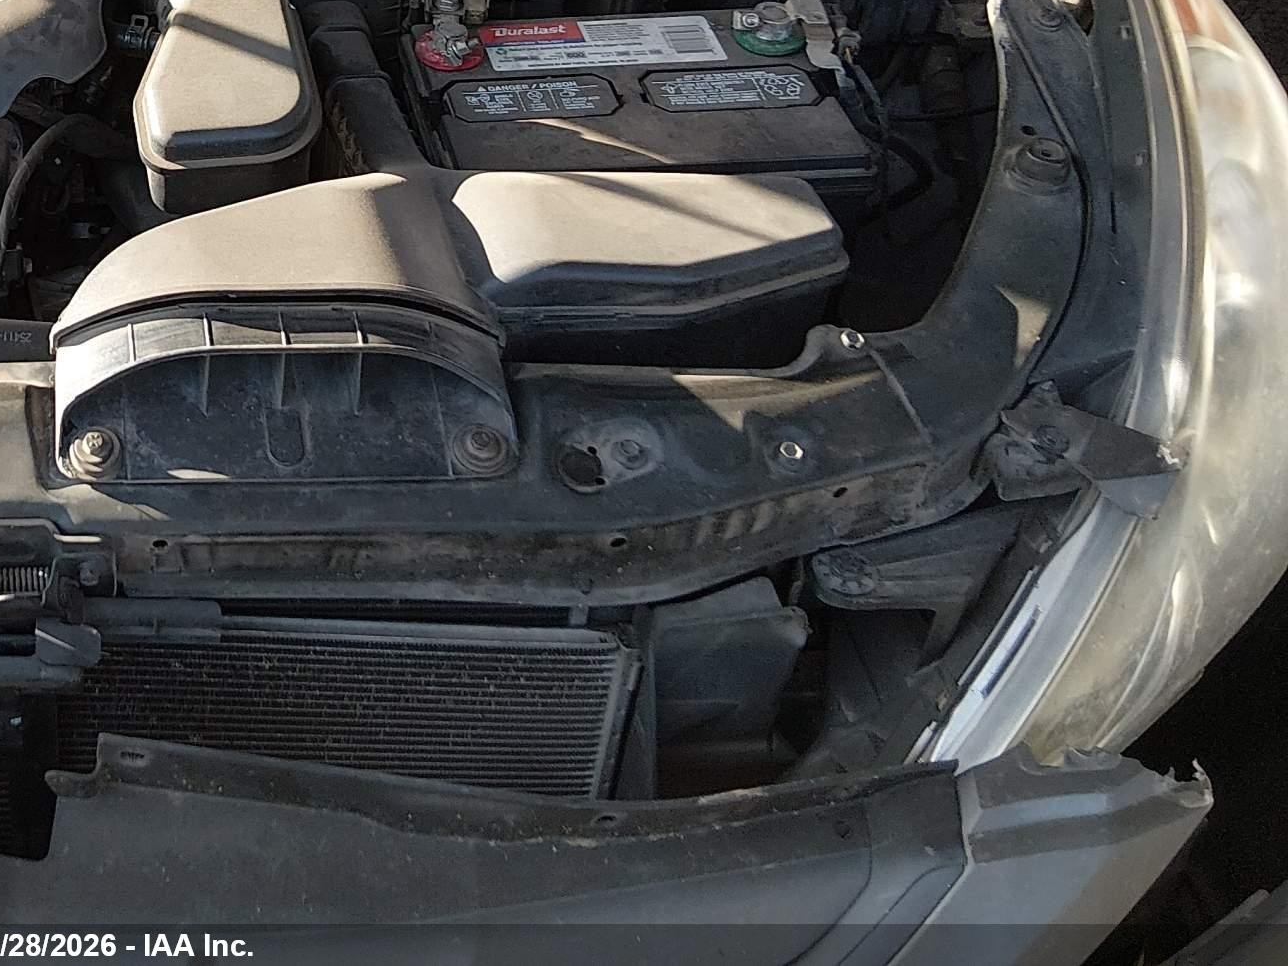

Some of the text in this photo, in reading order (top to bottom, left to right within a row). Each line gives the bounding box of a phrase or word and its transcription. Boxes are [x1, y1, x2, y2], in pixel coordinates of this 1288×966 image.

[488, 25, 567, 37] Duralast
[487, 84, 529, 92] DANGER
[539, 81, 578, 89] POISON
